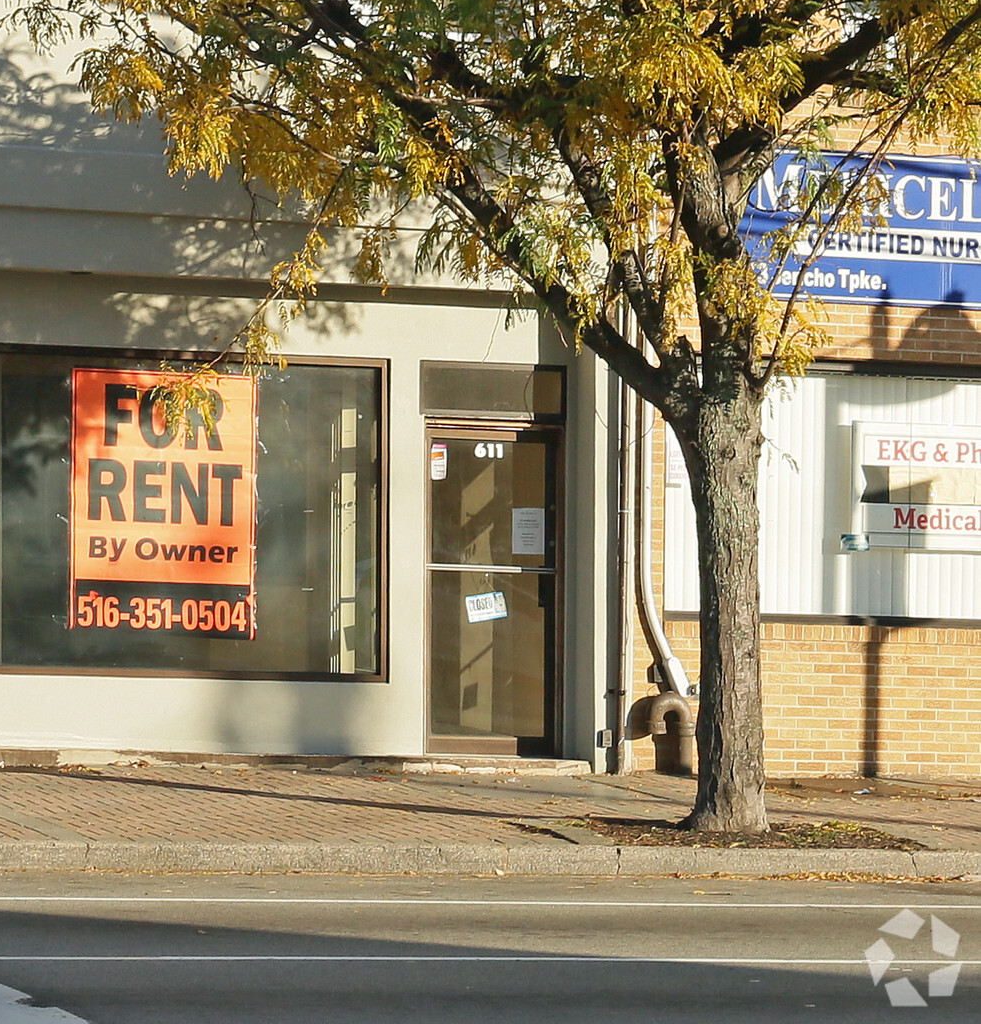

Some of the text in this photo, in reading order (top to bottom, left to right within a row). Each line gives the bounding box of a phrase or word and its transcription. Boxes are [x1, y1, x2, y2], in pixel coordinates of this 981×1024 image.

[807, 229, 925, 256] CERTIFIED
[838, 268, 887, 294] Tpke.
[103, 383, 224, 451] FOR
[474, 442, 503, 459] 611
[876, 439, 928, 462] EKG
[933, 442, 949, 463] &
[86, 457, 244, 527] RENT
[88, 535, 239, 564] By Owner
[77, 594, 247, 632] 516-351-0504
[468, 596, 494, 613] CLOSED
